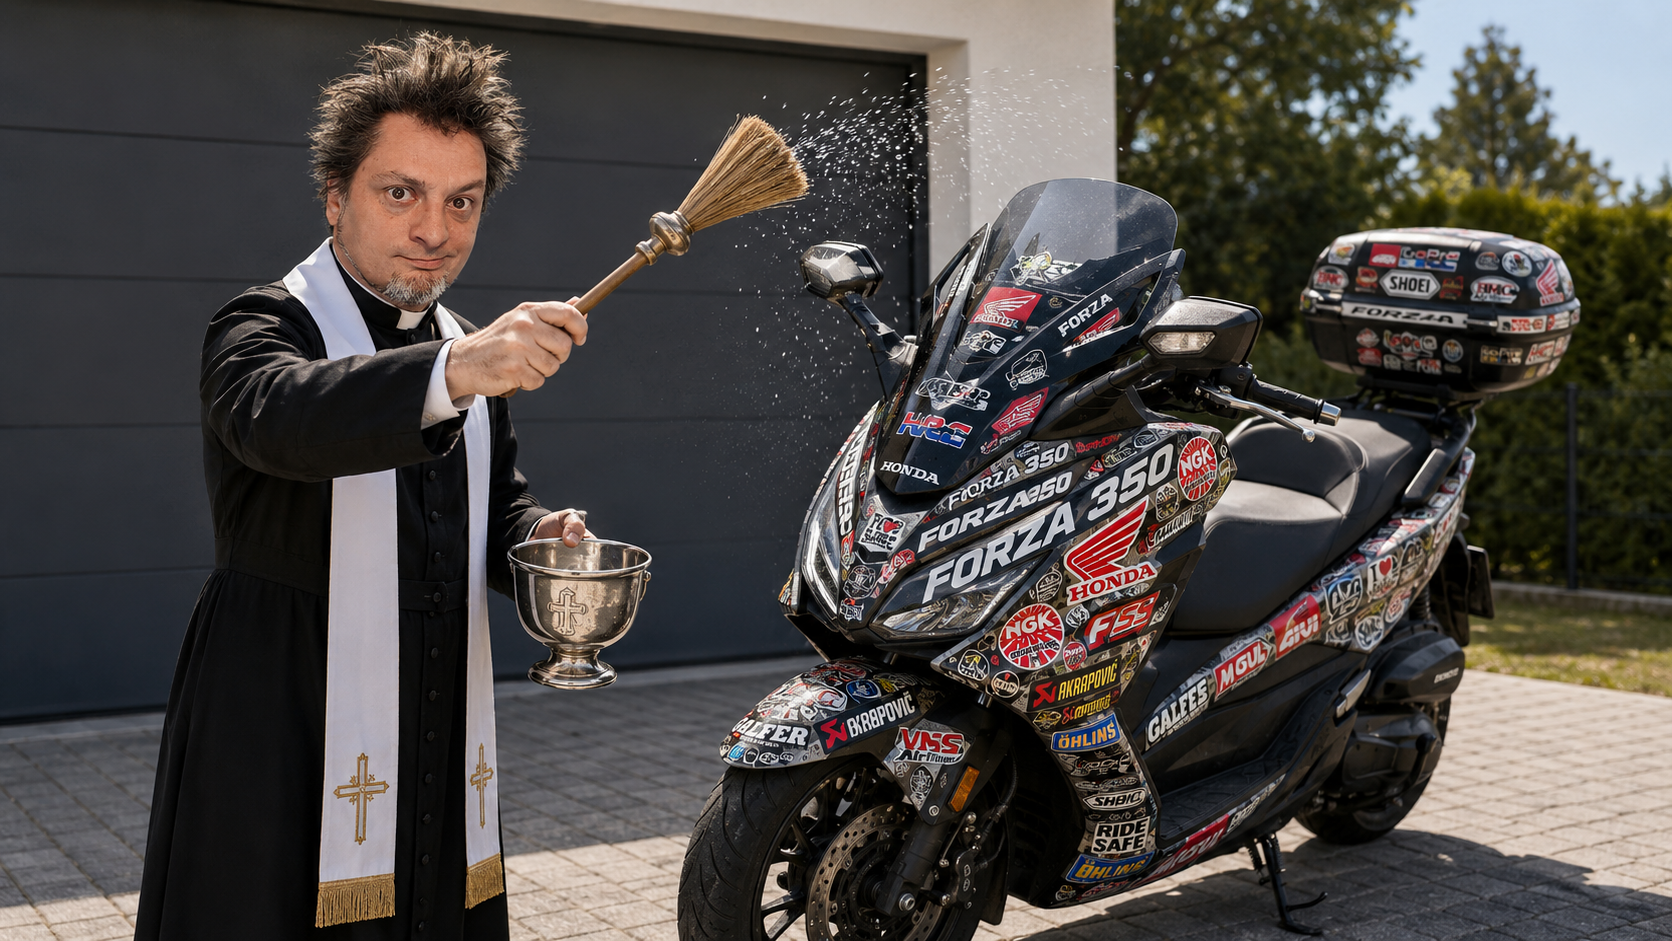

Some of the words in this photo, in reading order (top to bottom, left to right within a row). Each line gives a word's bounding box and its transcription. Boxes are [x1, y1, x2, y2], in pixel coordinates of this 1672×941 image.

[1390, 276, 1431, 293] SHOEI
[1058, 294, 1112, 337] FORZA
[1351, 306, 1455, 324] FORZA
[880, 461, 940, 485] HONDA
[1024, 442, 1070, 475] 350
[1180, 444, 1213, 477] NGK
[922, 501, 1076, 604] FORZA
[1087, 444, 1174, 522] 350
[1069, 563, 1156, 601] HONDA
[1005, 610, 1054, 640] NGK
[1093, 834, 1145, 852] SAFE
[1097, 819, 1147, 837] RIDE
